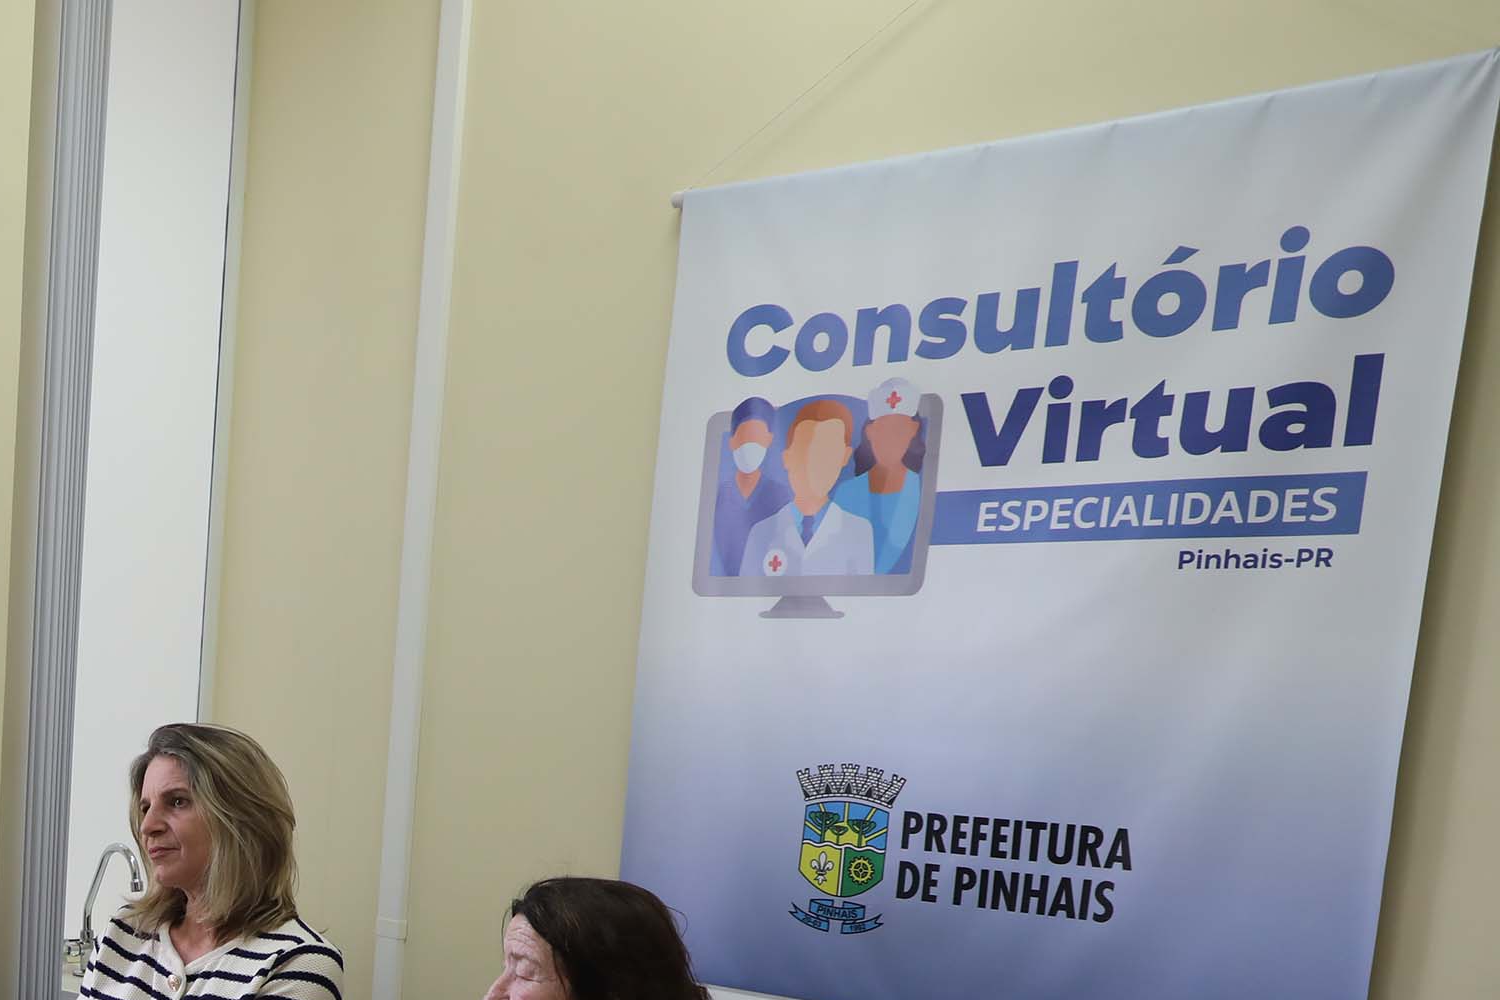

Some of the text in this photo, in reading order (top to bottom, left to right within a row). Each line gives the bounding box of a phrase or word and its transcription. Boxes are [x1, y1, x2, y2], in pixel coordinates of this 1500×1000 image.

[726, 226, 1395, 377] Consultório
[960, 353, 1386, 467] Virtual
[976, 486, 1340, 533] ESPECIALIDADES
[1177, 547, 1334, 570] Pinhais-PR
[900, 811, 1133, 871] PREFEITURA
[817, 906, 858, 919] PINHAIS
[895, 861, 1116, 924] DE PINHAIS
